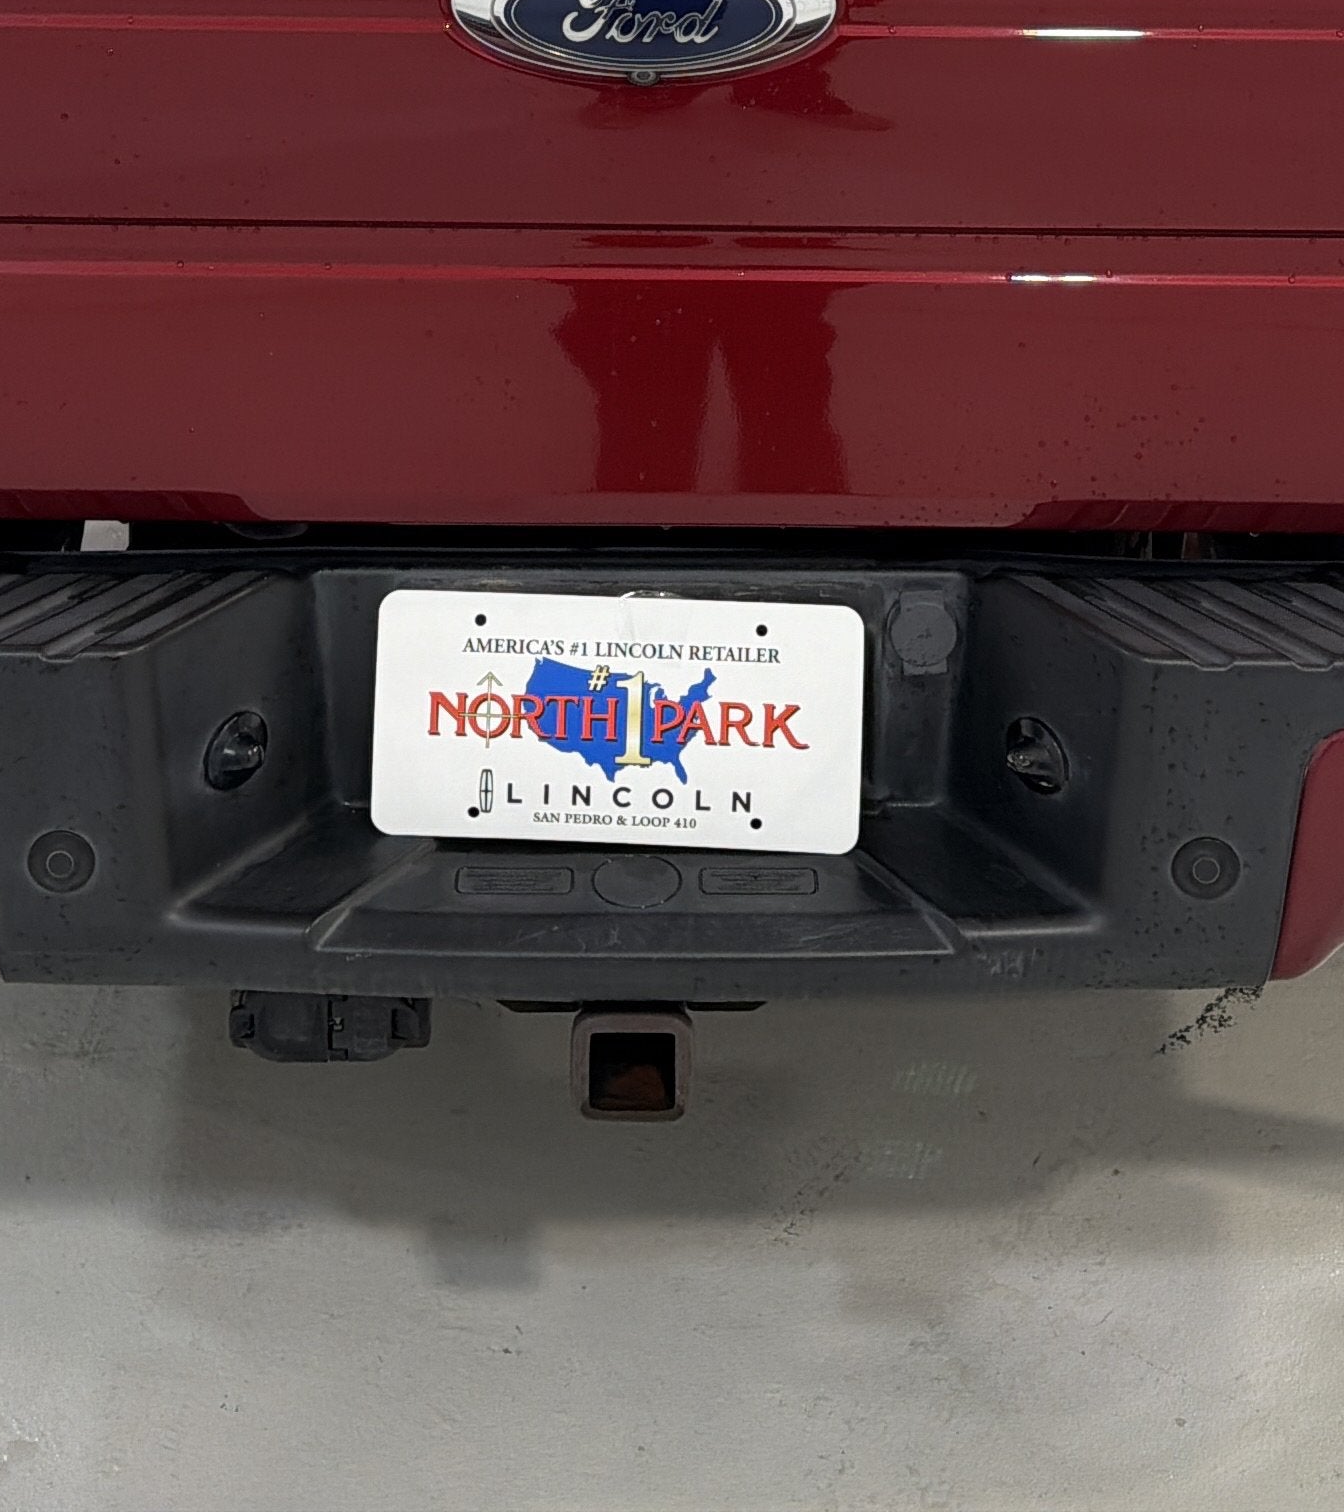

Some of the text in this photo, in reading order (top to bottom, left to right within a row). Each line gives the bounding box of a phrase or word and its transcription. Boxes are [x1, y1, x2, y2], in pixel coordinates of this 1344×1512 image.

[462, 637, 781, 664] AMERICA'S #1 LINCOLN RETAILER
[428, 691, 810, 750] NORTH PARK
[506, 782, 752, 813] LINCOLN
[532, 811, 698, 829] SAN PEDRO & LOOP 410
